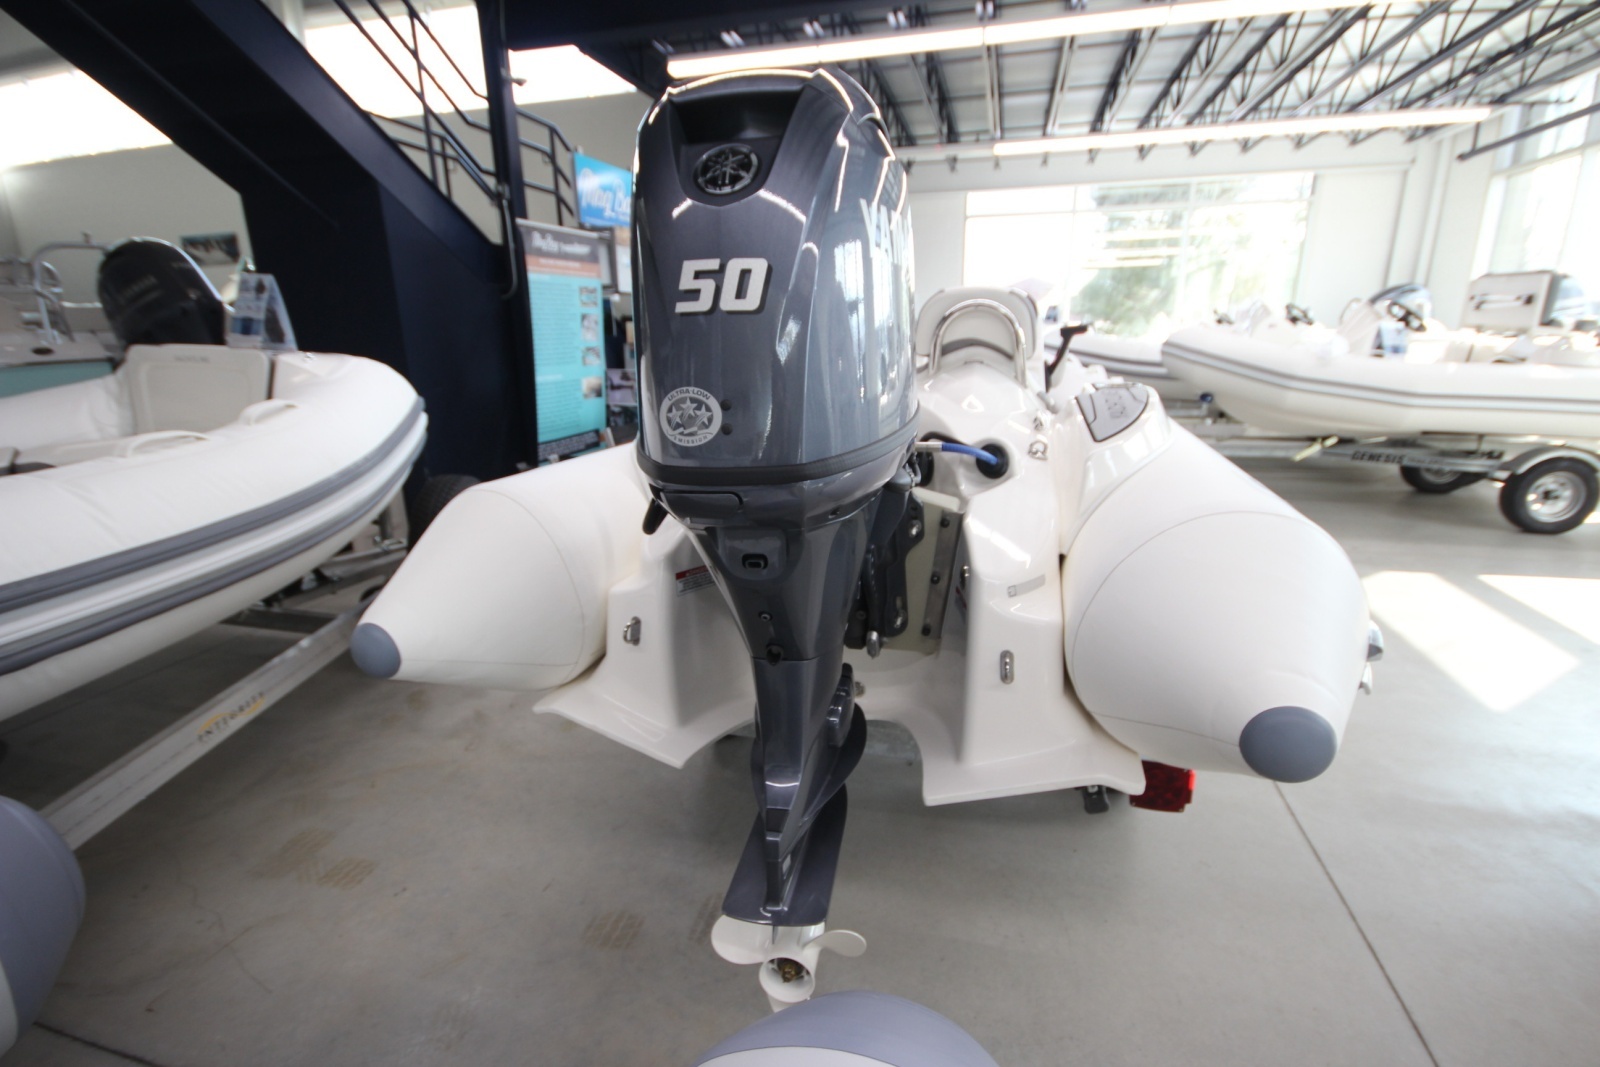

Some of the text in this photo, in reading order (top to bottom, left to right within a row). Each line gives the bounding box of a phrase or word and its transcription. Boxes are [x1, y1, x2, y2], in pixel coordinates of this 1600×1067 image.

[675, 258, 771, 315] 50
[673, 435, 708, 445] EMISSION
[1351, 451, 1406, 464] GENESIS
